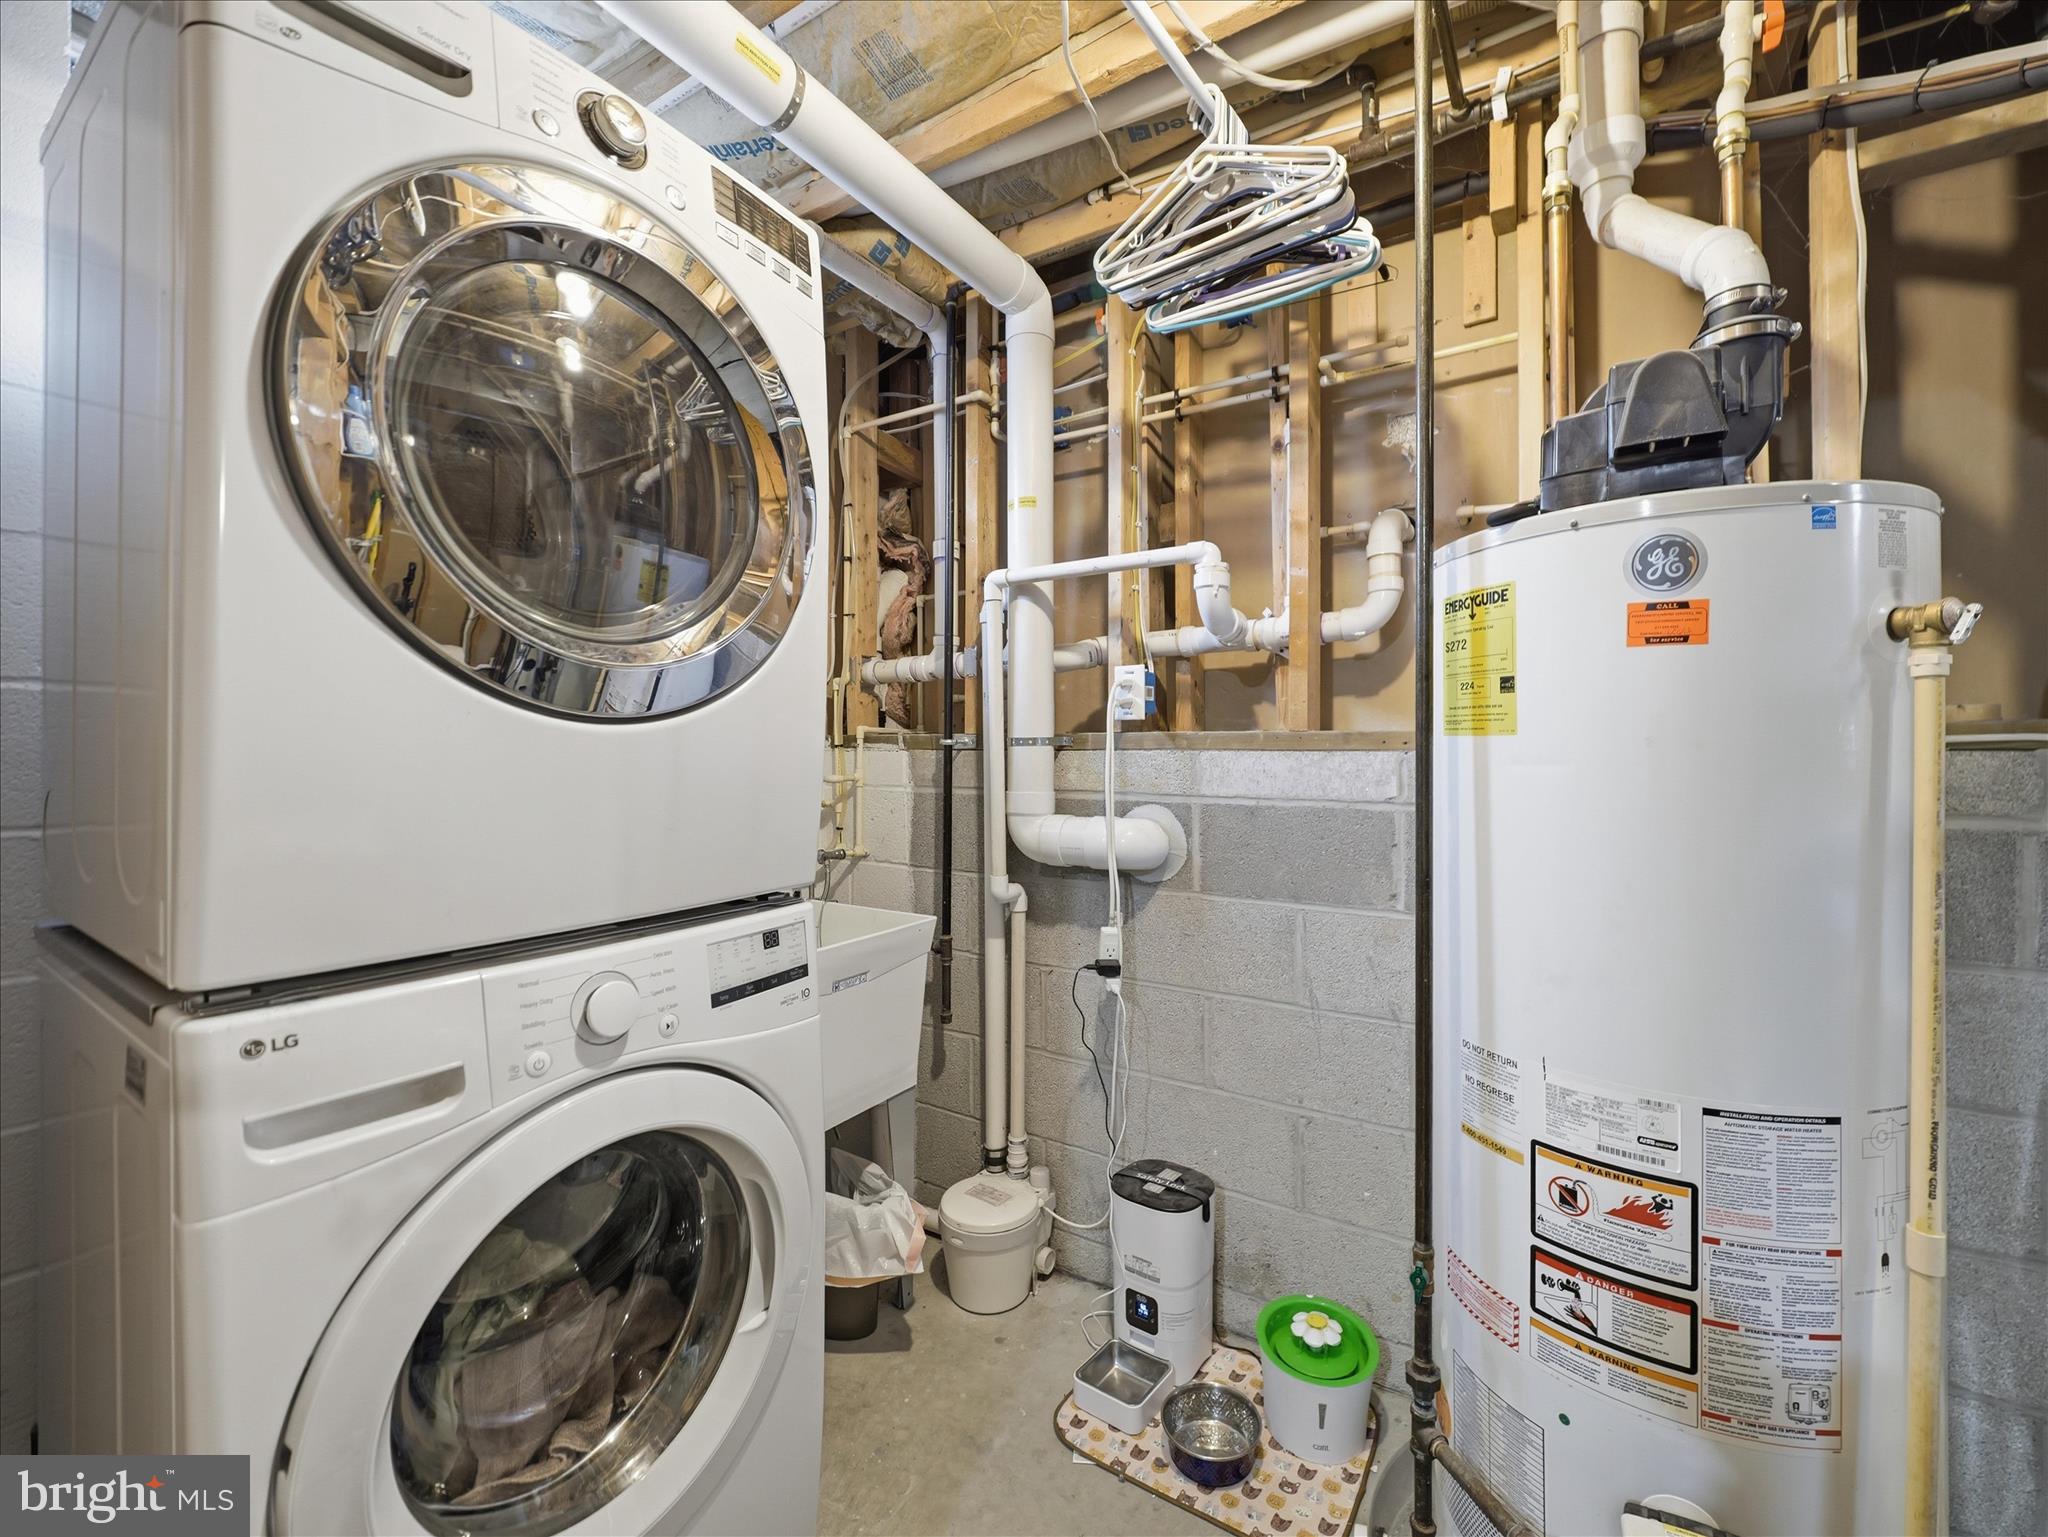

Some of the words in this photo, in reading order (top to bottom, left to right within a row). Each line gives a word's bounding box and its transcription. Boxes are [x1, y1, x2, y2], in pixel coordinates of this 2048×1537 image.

[1646, 546, 1685, 580] GE
[1445, 588, 1509, 616] ENERGYGUIDE
[1460, 682, 1474, 691] 224
[271, 1034, 299, 1052] LG
[1462, 1039, 1471, 1050] DO
[1472, 1044, 1485, 1056] NOT
[1486, 1050, 1518, 1069] RETURN
[1465, 1073, 1475, 1086] NO
[1476, 1080, 1515, 1104] REGRESE
[1136, 1171, 1164, 1186] Safety
[1165, 1180, 1187, 1192] Lock
[1587, 1165, 1644, 1187] WARNING
[1586, 1275, 1634, 1298] DANGER
[1588, 1348, 1640, 1374] WARNING
